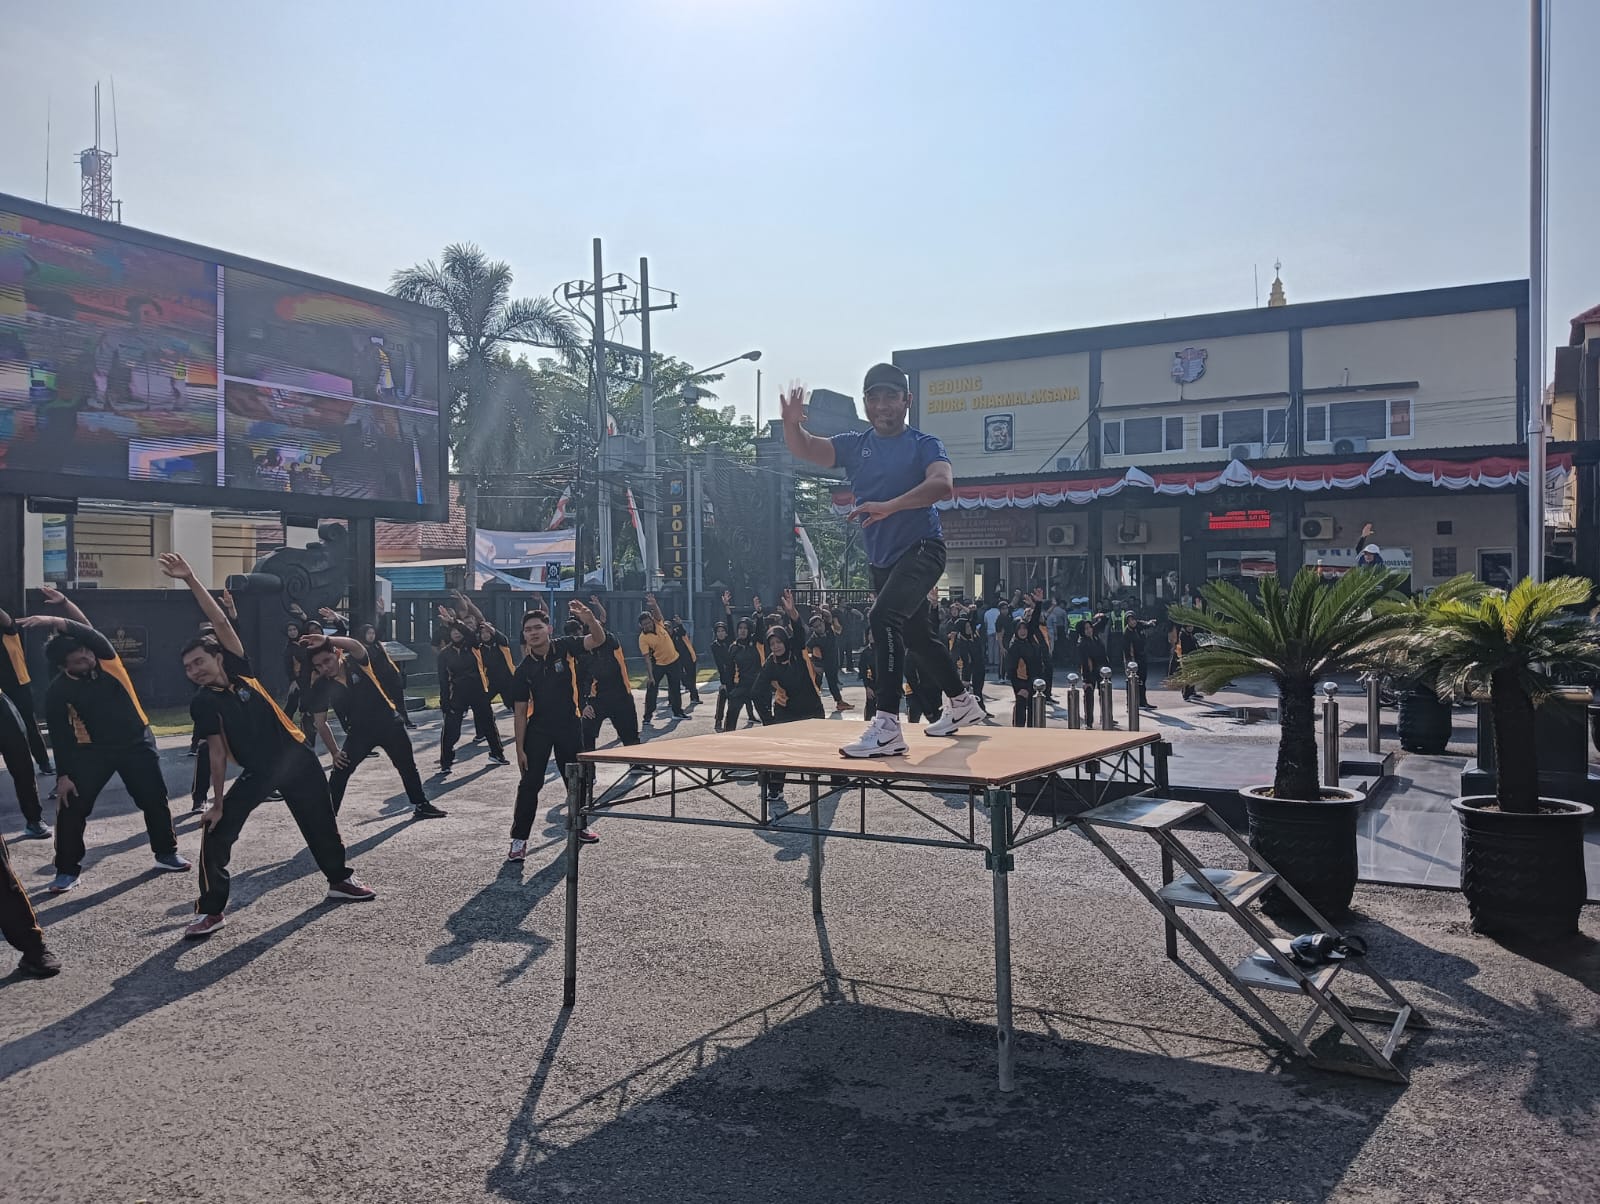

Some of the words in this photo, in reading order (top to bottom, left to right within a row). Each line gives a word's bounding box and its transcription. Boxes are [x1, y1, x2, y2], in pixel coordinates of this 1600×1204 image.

[928, 377, 982, 395] GEDUNG
[928, 398, 966, 413] ENDRA
[671, 504, 683, 578] POLIS
